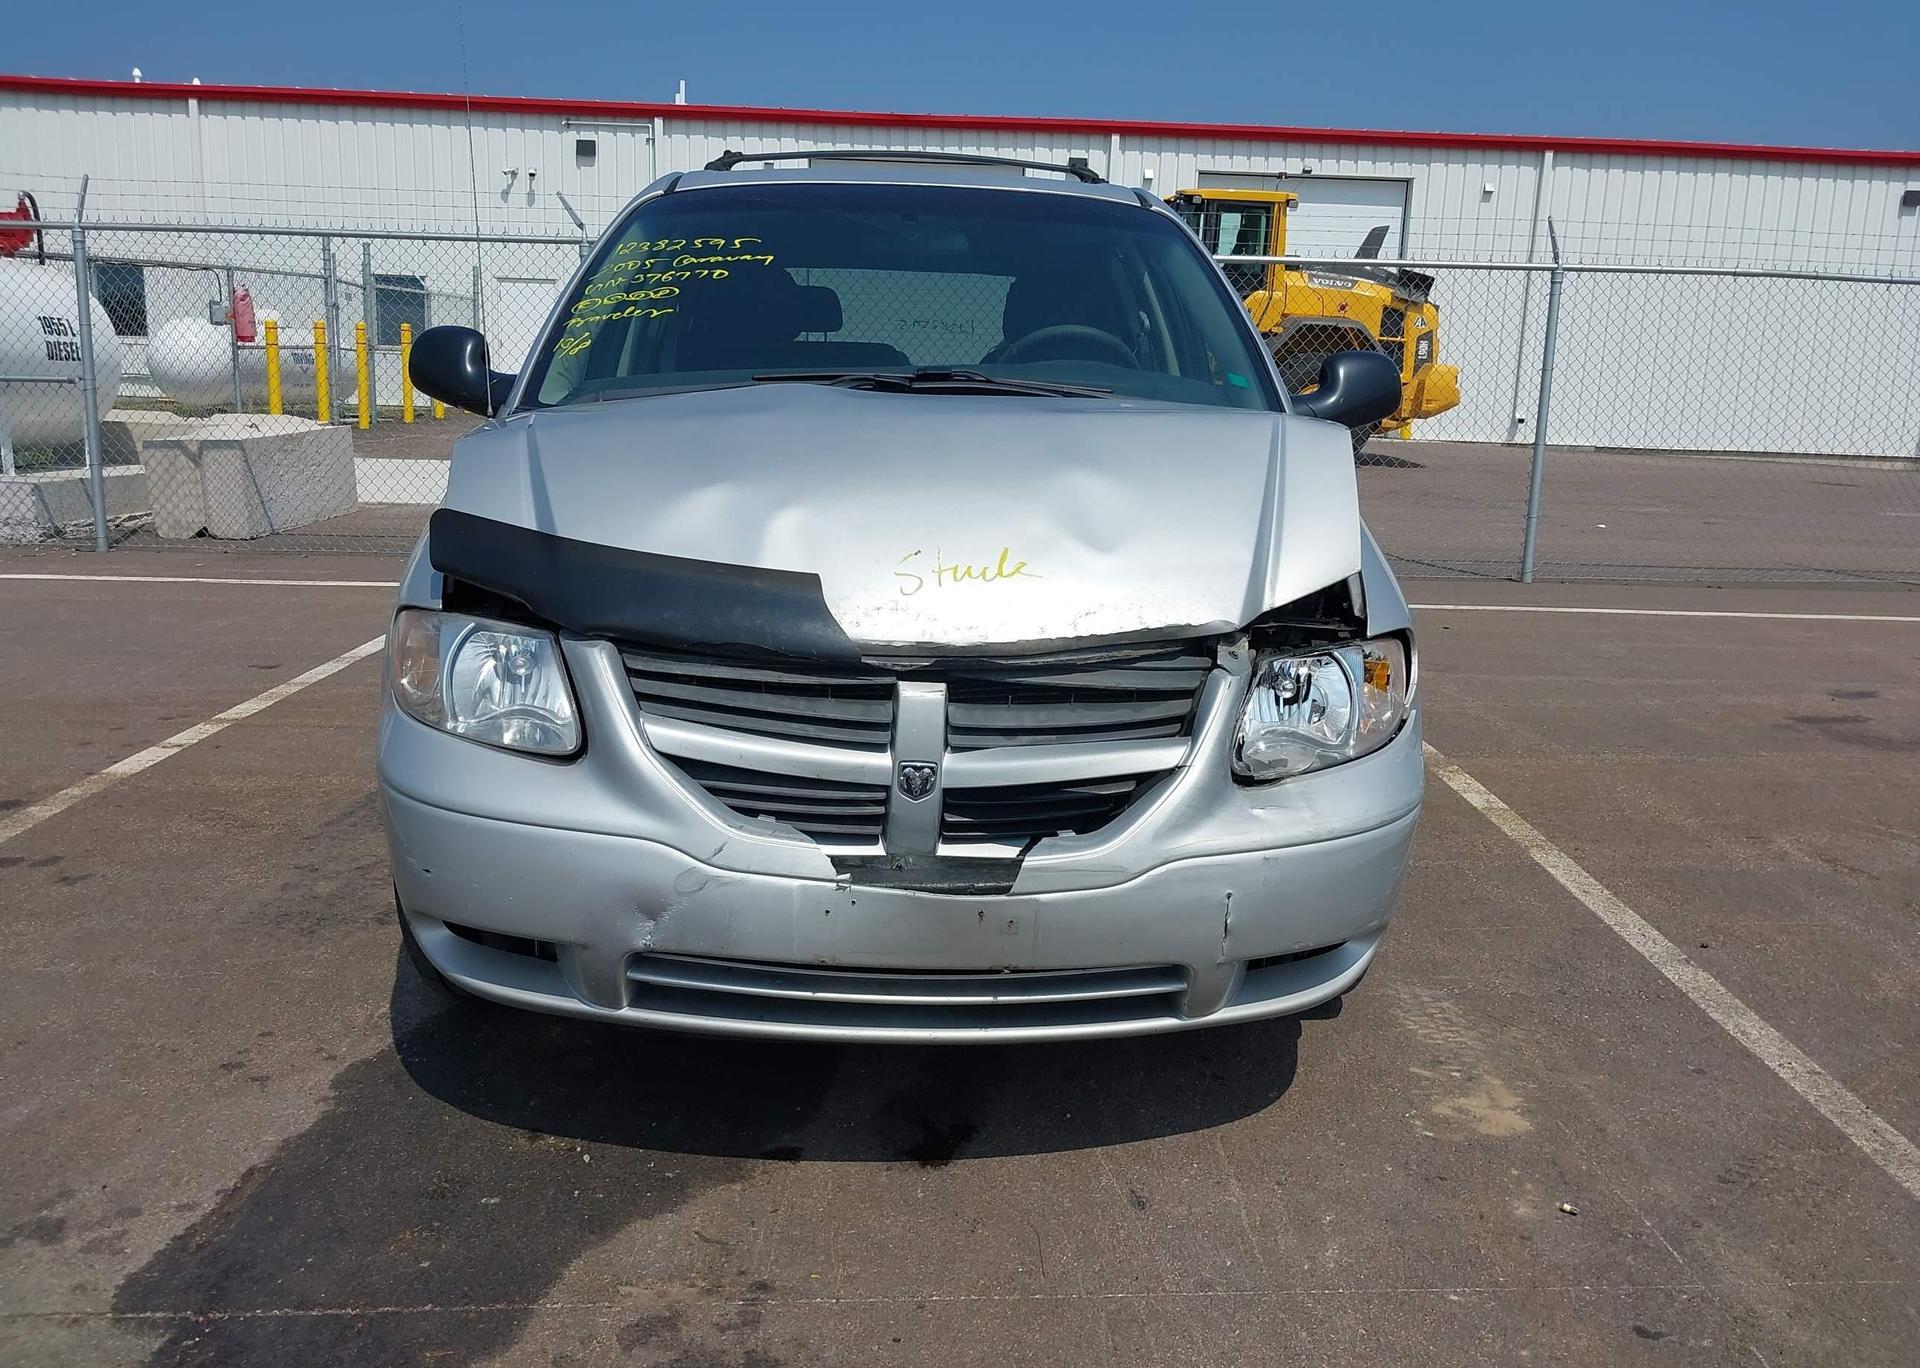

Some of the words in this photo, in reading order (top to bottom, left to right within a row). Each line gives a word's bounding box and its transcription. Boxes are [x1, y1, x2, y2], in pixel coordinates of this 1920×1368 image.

[614, 237, 762, 258] 12382595
[1312, 276, 1352, 288] VOLVO
[37, 315, 69, 337] 1955
[66, 318, 76, 337] L
[44, 340, 82, 361] DIESEL
